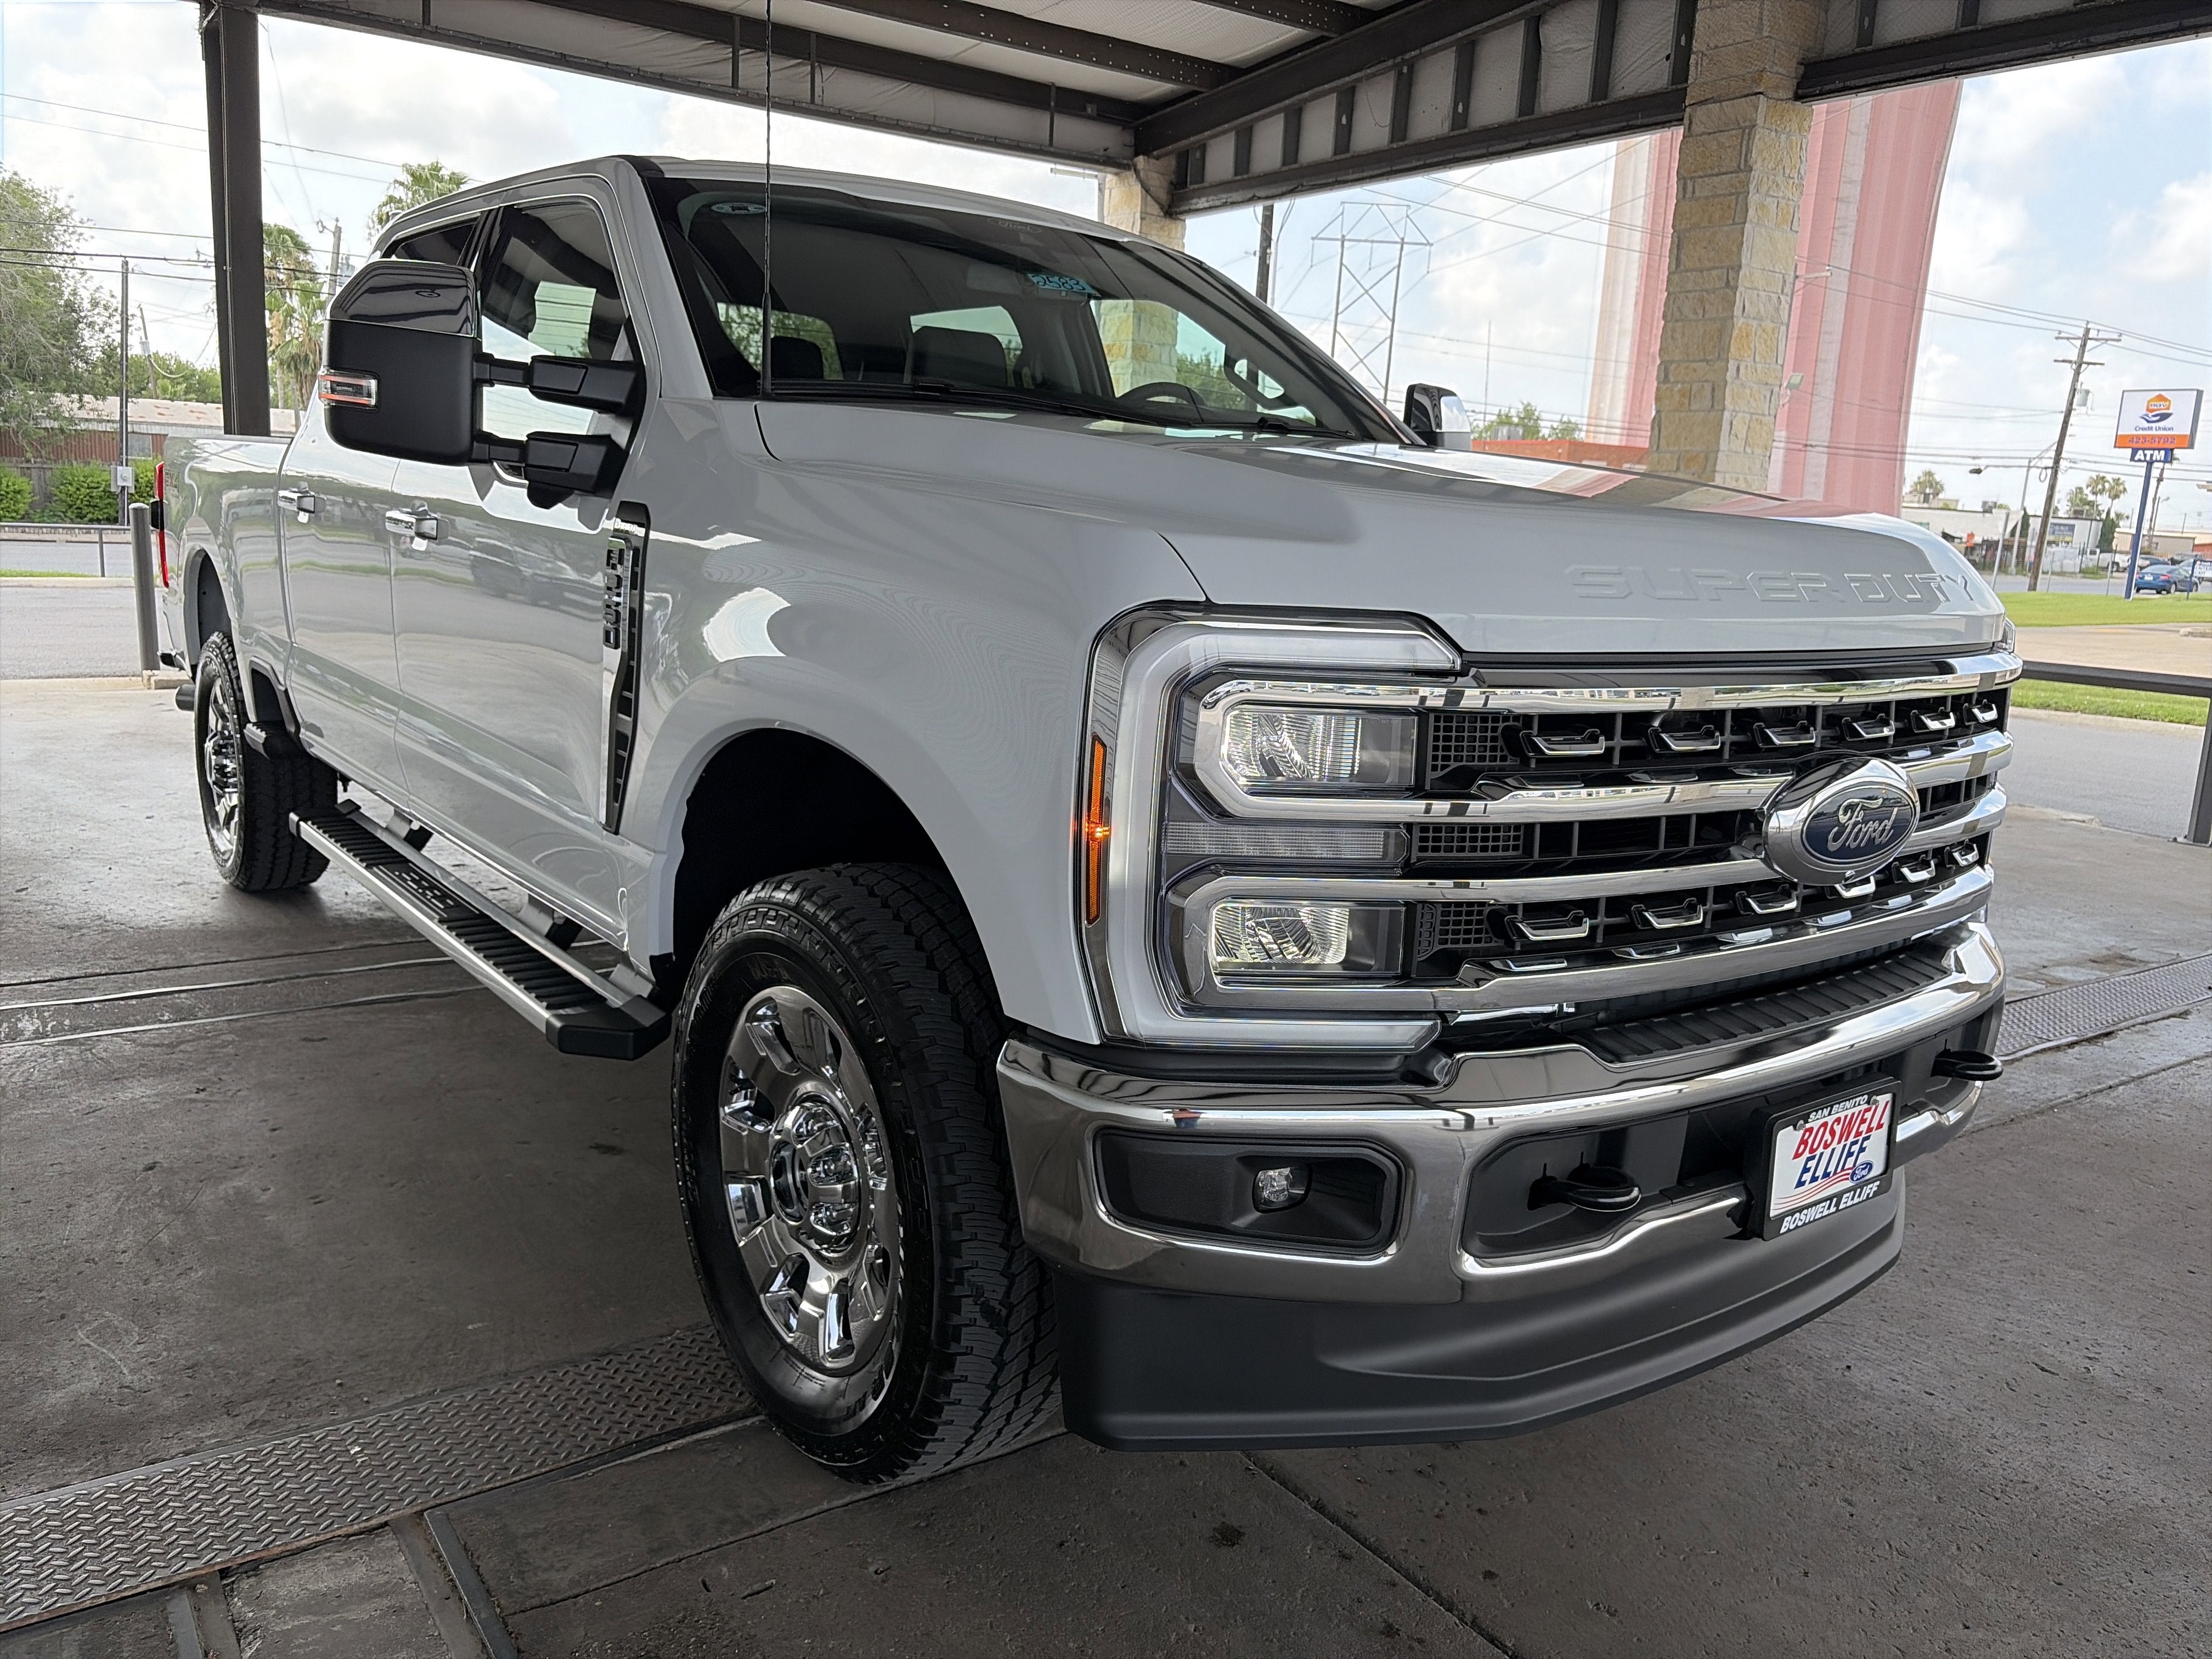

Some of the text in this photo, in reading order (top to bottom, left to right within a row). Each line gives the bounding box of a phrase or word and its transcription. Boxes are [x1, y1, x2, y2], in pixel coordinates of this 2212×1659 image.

[1031, 275, 1086, 291] 2583
[2135, 450, 2165, 460] ATM
[1564, 566, 1976, 604] SUPER DUTY
[1827, 798, 1898, 851] Ford
[1808, 1094, 1869, 1122] SAN BENITO
[1792, 1101, 1890, 1160] BOSWELL
[1793, 1134, 1872, 1189] ELLIFF
[1853, 1165, 1871, 1181] Ford
[1779, 1181, 1881, 1234] BOSWELL ELLIFF
